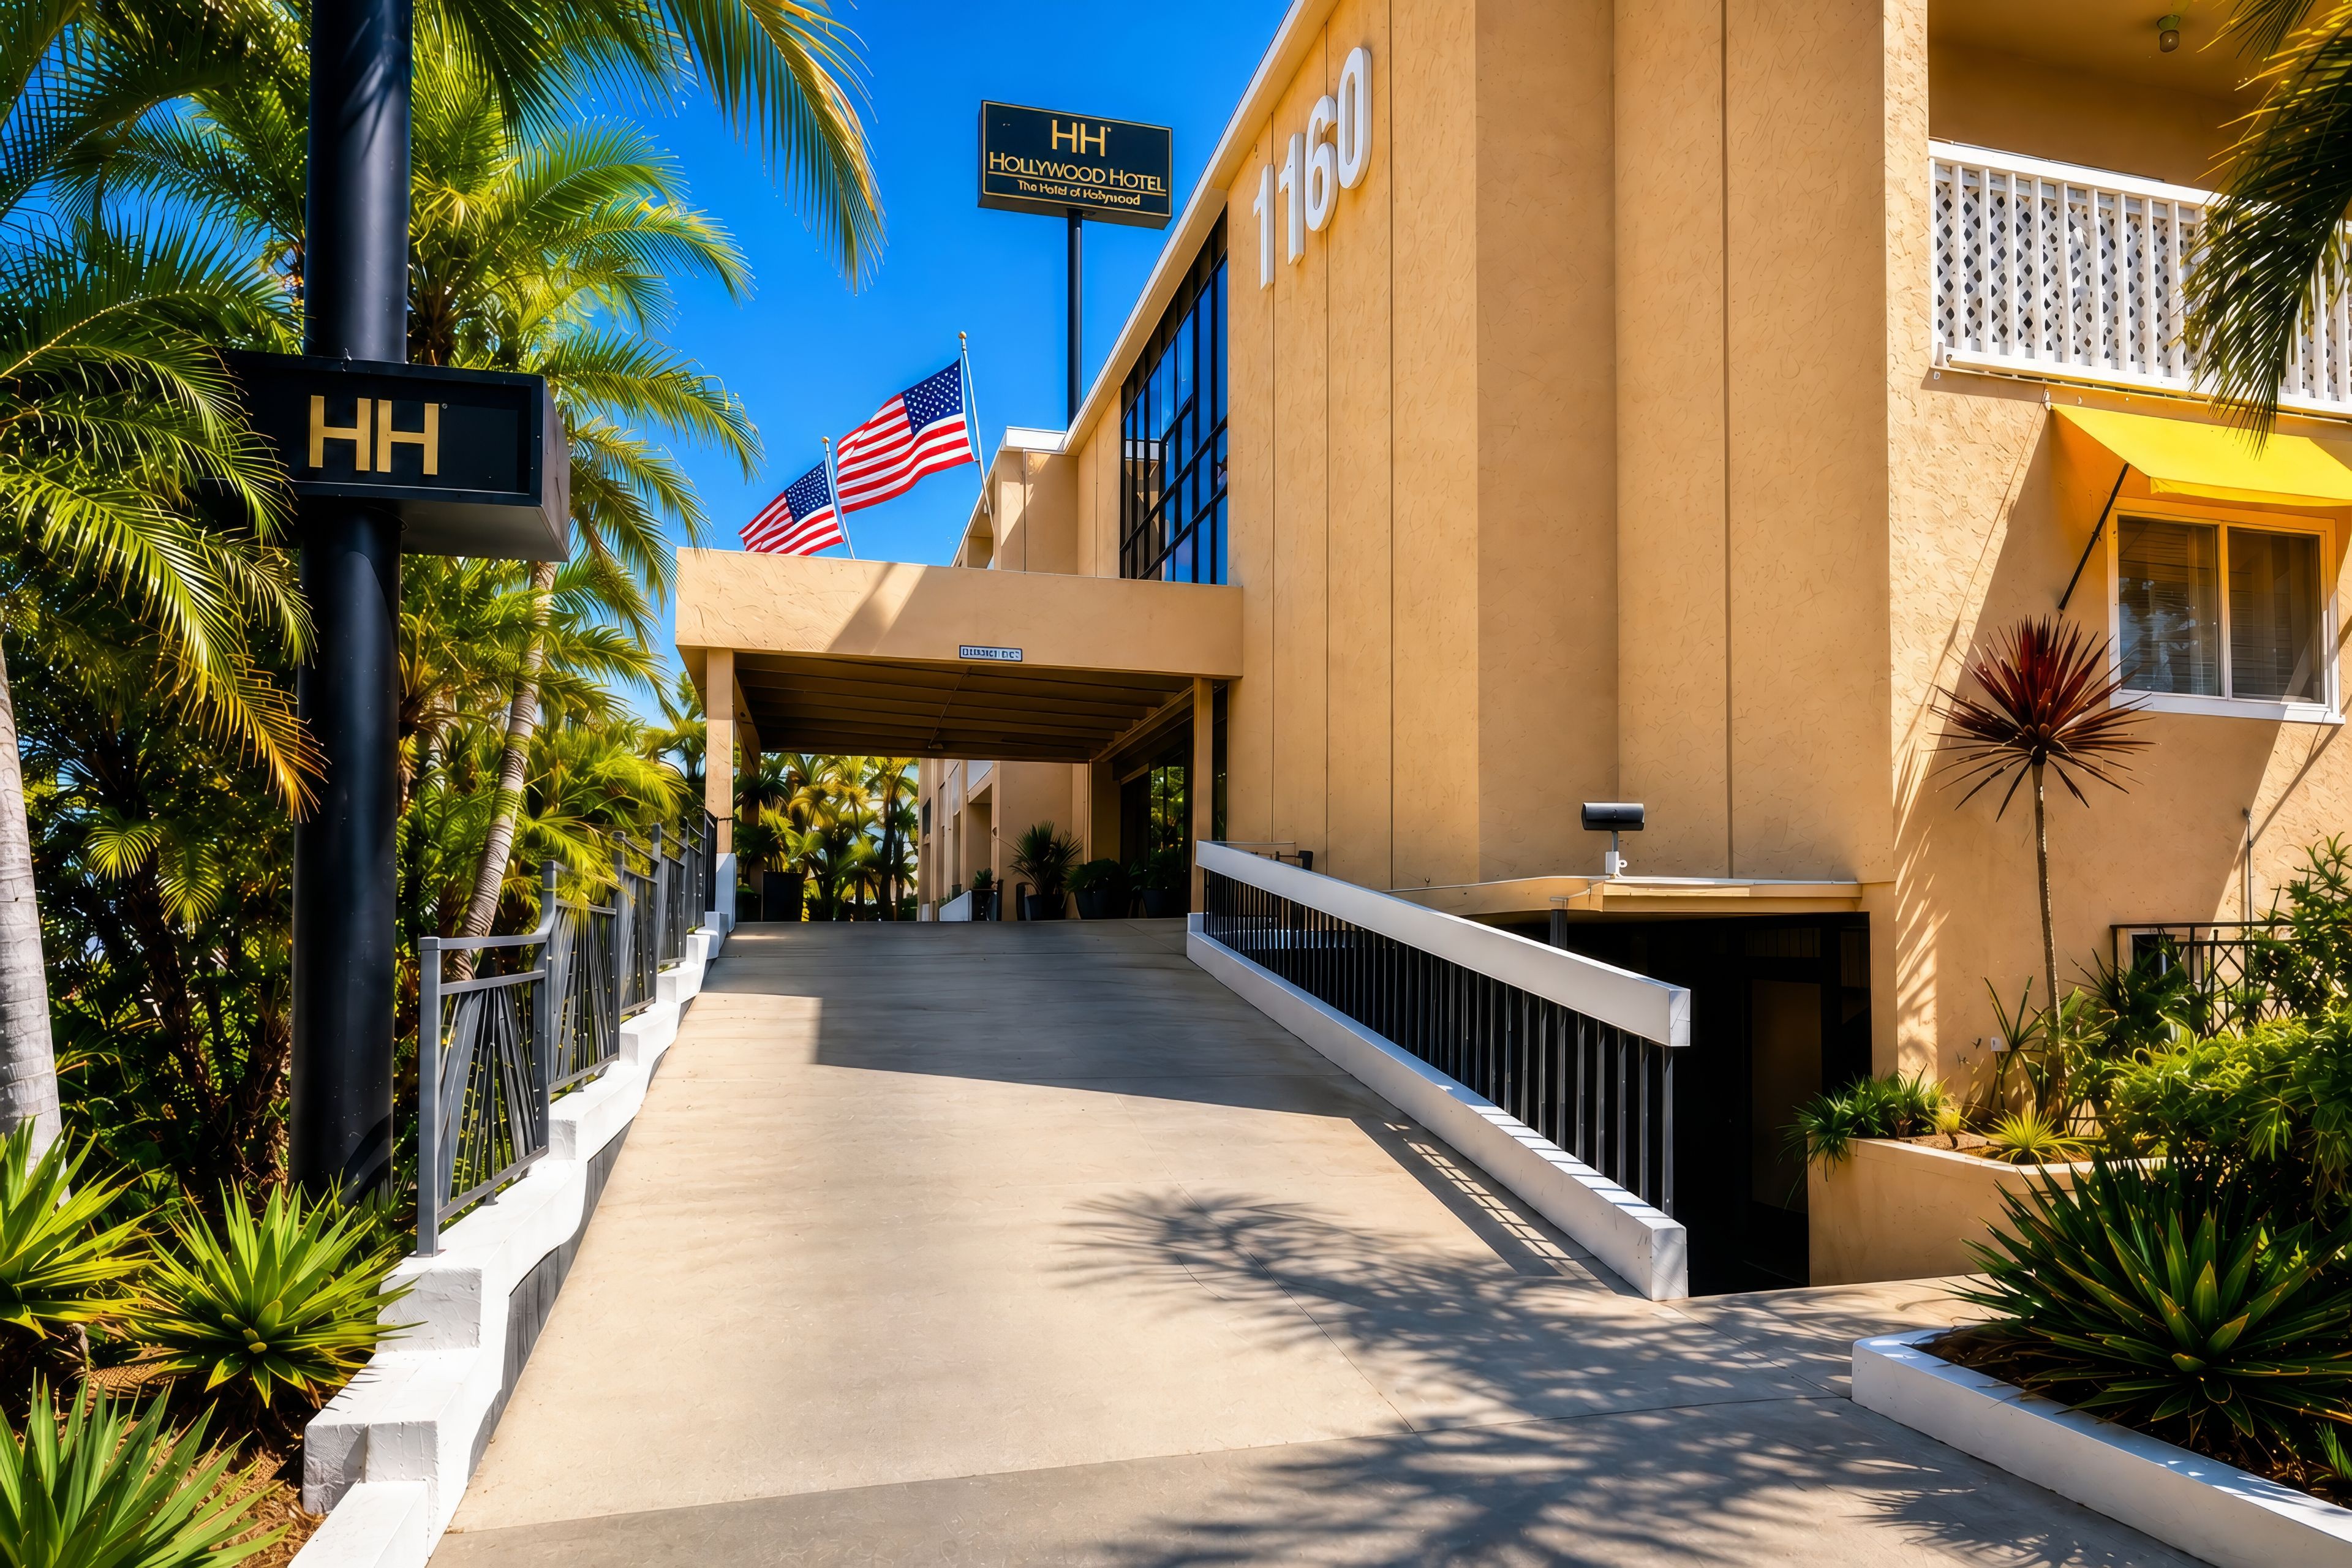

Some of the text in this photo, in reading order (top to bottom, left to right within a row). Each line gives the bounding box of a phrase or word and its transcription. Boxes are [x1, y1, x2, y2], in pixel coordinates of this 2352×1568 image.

[1052, 119, 1106, 157] HH
[989, 151, 1167, 192] HOLLYWOOD HOTEL
[1253, 47, 1372, 291] 1160
[309, 395, 439, 475] HH
